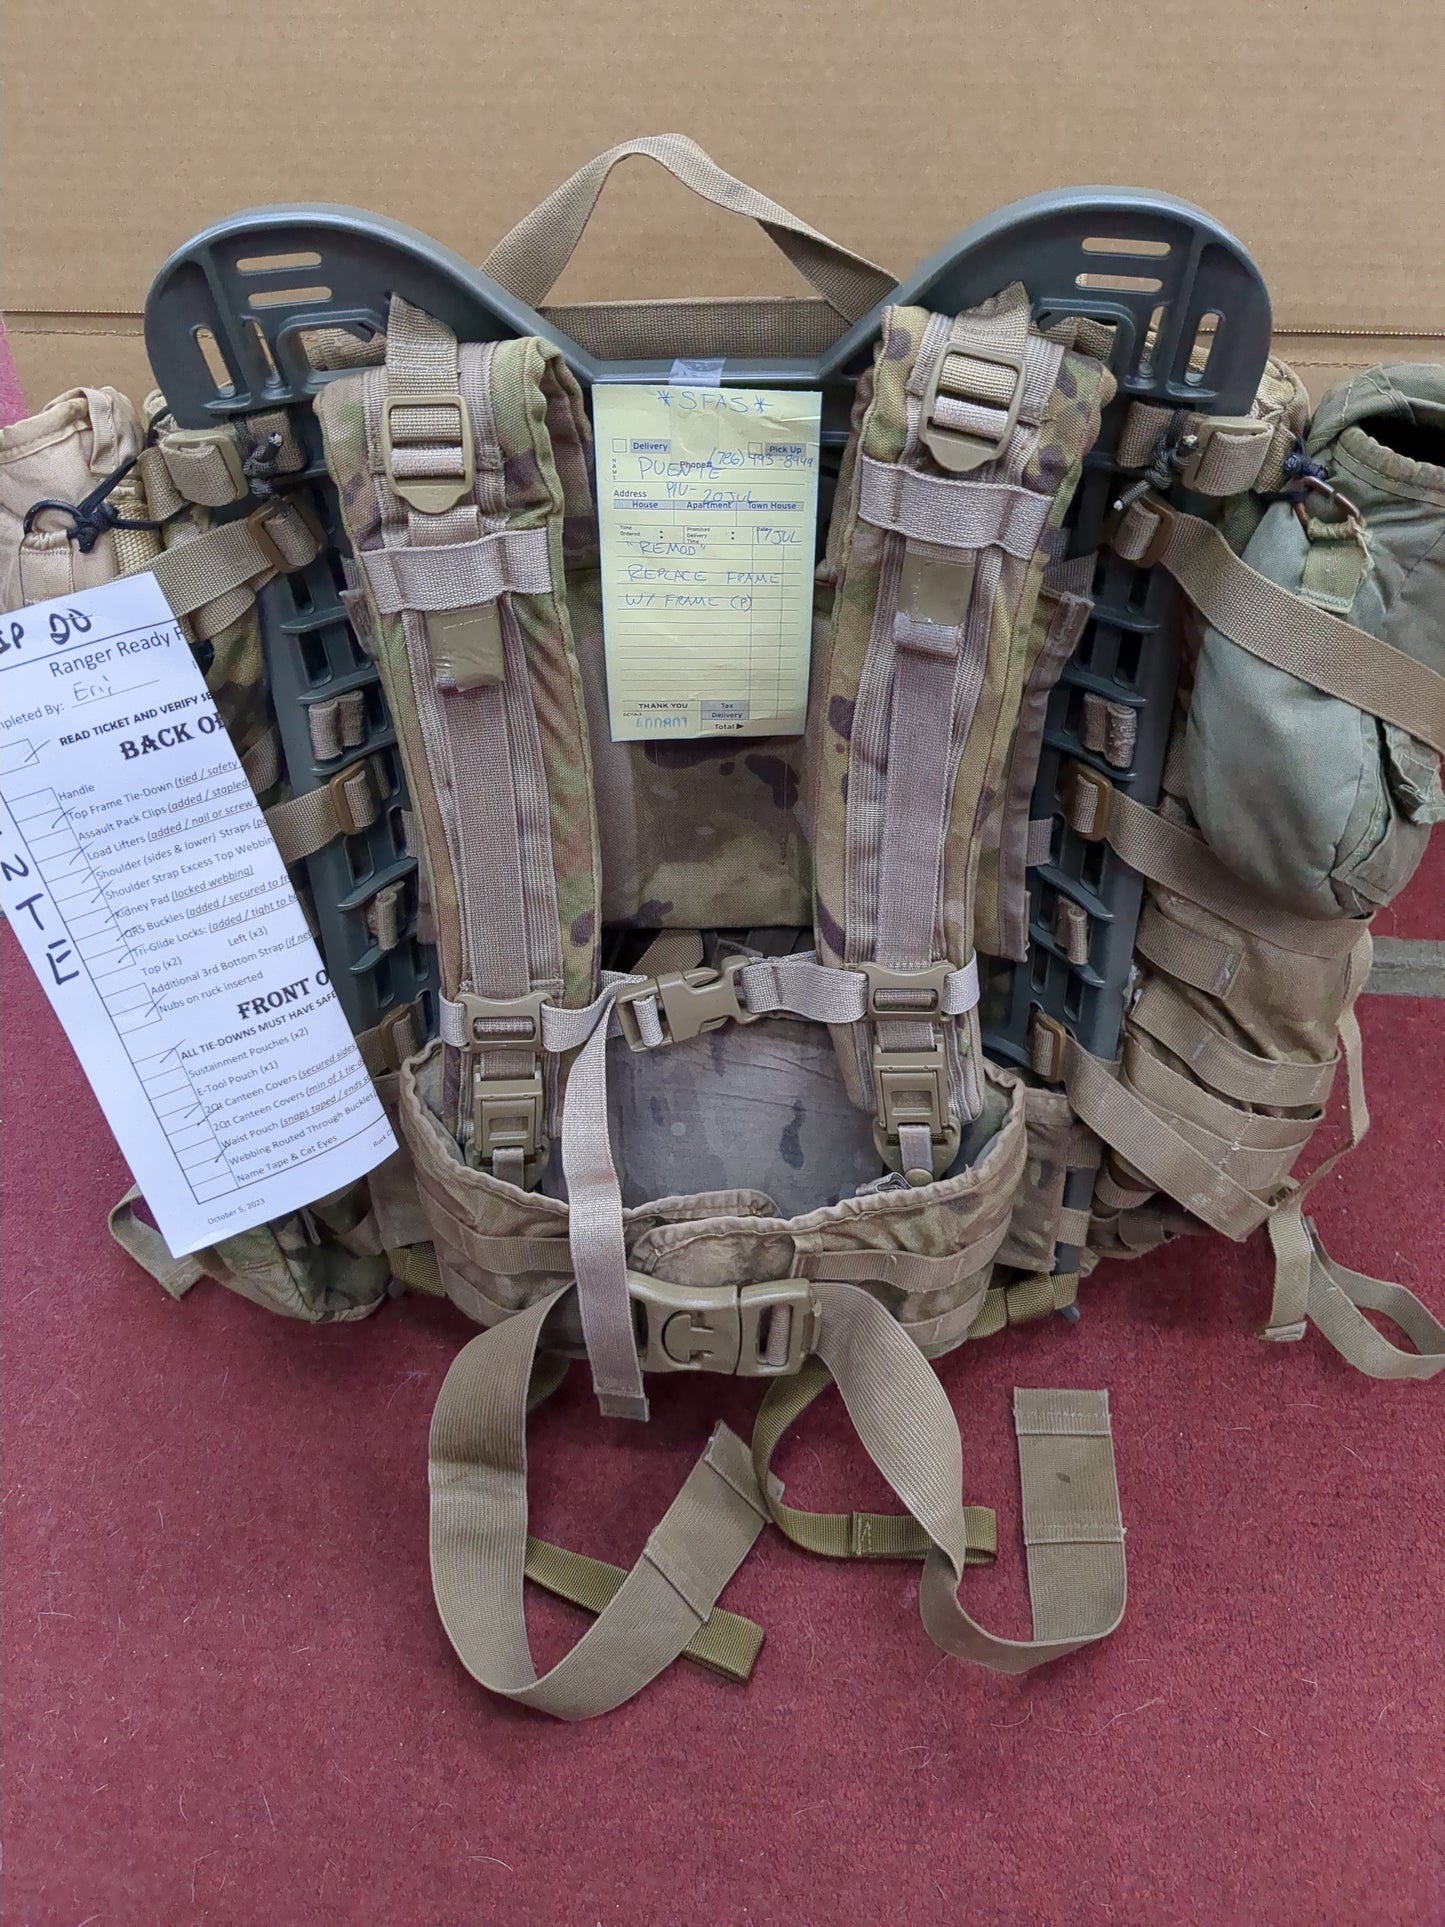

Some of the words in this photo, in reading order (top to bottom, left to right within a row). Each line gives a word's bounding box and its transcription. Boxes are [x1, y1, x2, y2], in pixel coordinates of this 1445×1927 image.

[633, 442, 668, 452] Delivery
[637, 457, 720, 480] PUENTE
[769, 445, 788, 453] Pick
[790, 446, 802, 454] Up
[613, 489, 647, 498] Address
[632, 501, 658, 509] House
[686, 501, 731, 510] Apartment
[769, 502, 797, 510] House
[627, 564, 707, 582] REPLACE
[727, 572, 782, 585] FRAME
[664, 593, 719, 607] FRAME
[49, 647, 113, 678] Ranger
[116, 632, 171, 657] Ready
[44, 703, 65, 716] By:
[59, 729, 91, 747] READ
[92, 717, 131, 738] TICKET
[133, 707, 158, 724] AND
[160, 695, 199, 714] VERIFY
[119, 722, 195, 760] BACK
[57, 783, 96, 801] Handle
[67, 809, 88, 821] Top
[89, 797, 123, 815] Frame
[123, 781, 174, 803] Tie-Down
[208, 761, 238, 776] safety
[78, 822, 116, 841] Assault
[116, 814, 141, 831] Pack
[142, 806, 168, 823] Clips
[168, 793, 203, 813] (added
[212, 778, 248, 796] stapled
[86, 846, 113, 861] Load
[114, 834, 147, 855] Lifters
[148, 821, 182, 842] (added
[192, 812, 210, 825] nail
[212, 809, 222, 819] or
[225, 800, 253, 814] screw
[97, 860, 143, 881] Shoulder
[143, 849, 172, 868] (sides
[174, 844, 183, 854] &
[184, 833, 217, 851] lower)
[219, 823, 252, 838] Straps
[105, 879, 151, 901] Shoulder
[152, 866, 180, 884] Strap
[180, 858, 214, 874] Excess
[214, 851, 235, 863] Top
[115, 902, 150, 921] Kidney
[150, 894, 170, 909] Pad
[171, 881, 206, 900] (locked
[208, 864, 255, 887] webbing)
[125, 924, 146, 939] QRS
[146, 911, 185, 931] Buckles
[185, 899, 219, 920] (added
[229, 883, 266, 902] secured
[268, 879, 279, 889] to
[132, 934, 178, 958] Tri-Glide
[178, 924, 209, 946] Locks:
[209, 913, 242, 934] (added
[251, 901, 274, 917] tight
[276, 897, 286, 907] to
[227, 933, 247, 947] Left
[248, 925, 269, 941] (x3)
[141, 964, 164, 977] Top
[163, 955, 183, 971] (x2)
[150, 970, 202, 996] Additional
[202, 963, 220, 978] 3rd
[220, 951, 258, 971] Bottom
[258, 941, 285, 958] Strap
[158, 997, 185, 1015] Nubs
[186, 993, 201, 1005] on
[201, 984, 223, 999] ruck
[224, 970, 264, 992] inserted
[236, 977, 311, 1020] FRONT
[181, 1045, 199, 1060] ALL
[199, 1027, 257, 1054] TIE-DOWNS
[257, 1014, 287, 1033] MUST
[288, 1003, 316, 1021] HAVE
[188, 1050, 248, 1079] Sustainment
[249, 1036, 290, 1058] Pouches
[291, 1026, 309, 1042] (x2)
[197, 1080, 229, 1097] E-Tool
[229, 1069, 259, 1088] Pouch
[260, 1060, 279, 1075] (x1)
[224, 1087, 264, 1108] Canteen
[265, 1075, 298, 1094] Covers
[298, 1054, 335, 1080] (secured
[336, 1043, 356, 1058] sides
[221, 1131, 249, 1149] Waist
[249, 1120, 280, 1140] Pouch
[281, 1108, 310, 1128] (snaps
[311, 1094, 337, 1114] taped
[343, 1081, 362, 1095] ends
[233, 1104, 272, 1125] Canteen
[272, 1091, 305, 1110] Covers
[306, 1080, 326, 1097] (min
[327, 1074, 337, 1084] of
[229, 1143, 271, 1167] Webbing
[272, 1128, 306, 1149] Routed
[306, 1112, 344, 1138] Through
[236, 1166, 264, 1184] Name
[265, 1158, 290, 1174] Tape
[290, 1152, 299, 1161] &
[300, 1144, 317, 1158] Cat
[317, 1134, 338, 1150] Eyes
[207, 1209, 238, 1225] October
[247, 1198, 266, 1210] 2023
